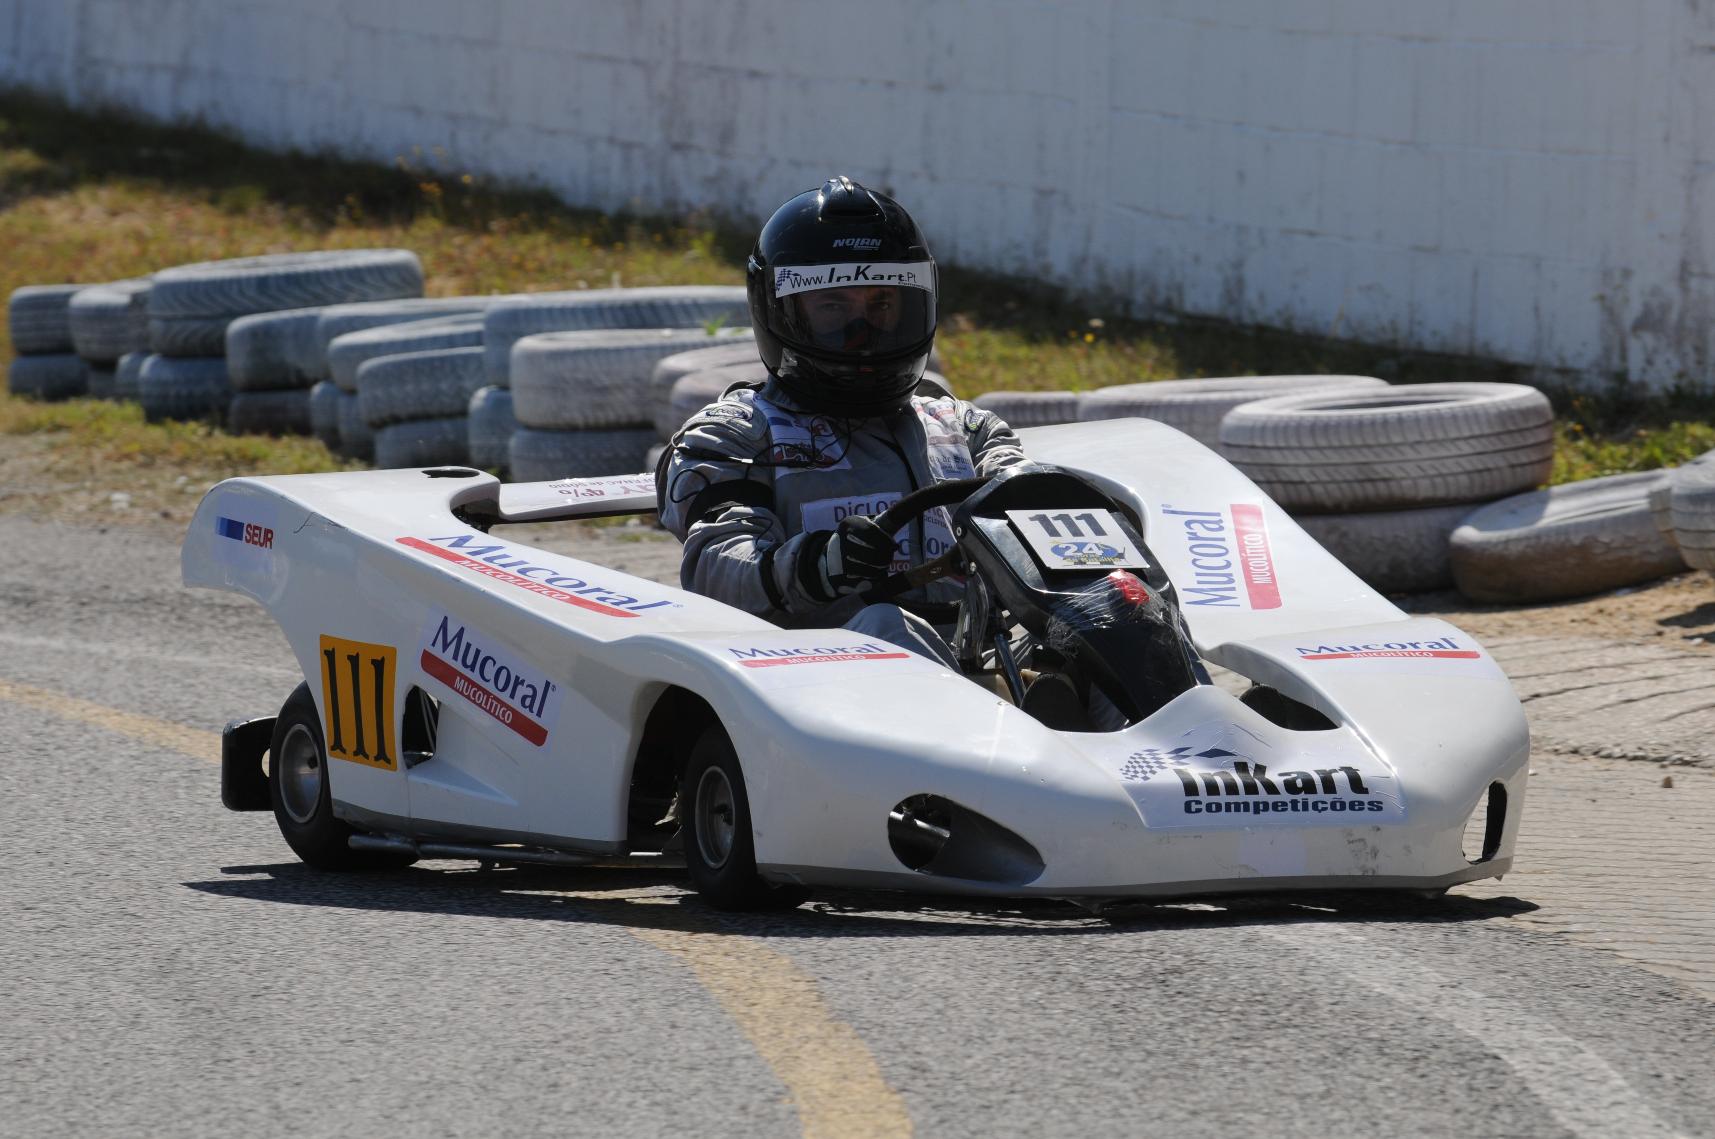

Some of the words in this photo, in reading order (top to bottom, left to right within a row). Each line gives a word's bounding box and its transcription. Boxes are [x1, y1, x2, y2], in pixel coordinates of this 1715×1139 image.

[244, 523, 274, 549] SEUR
[1028, 513, 1108, 537] 111
[1059, 543, 1104, 557] 24
[1161, 509, 1240, 607] Mucoral
[429, 534, 673, 611] Mucoral
[729, 643, 886, 659] Mucoral
[1296, 637, 1461, 655] Mucoral
[431, 615, 550, 719] Mucoral
[324, 648, 392, 765] 111
[453, 675, 513, 724] MUCOLÍTICO
[1184, 797, 1384, 815] Competições
